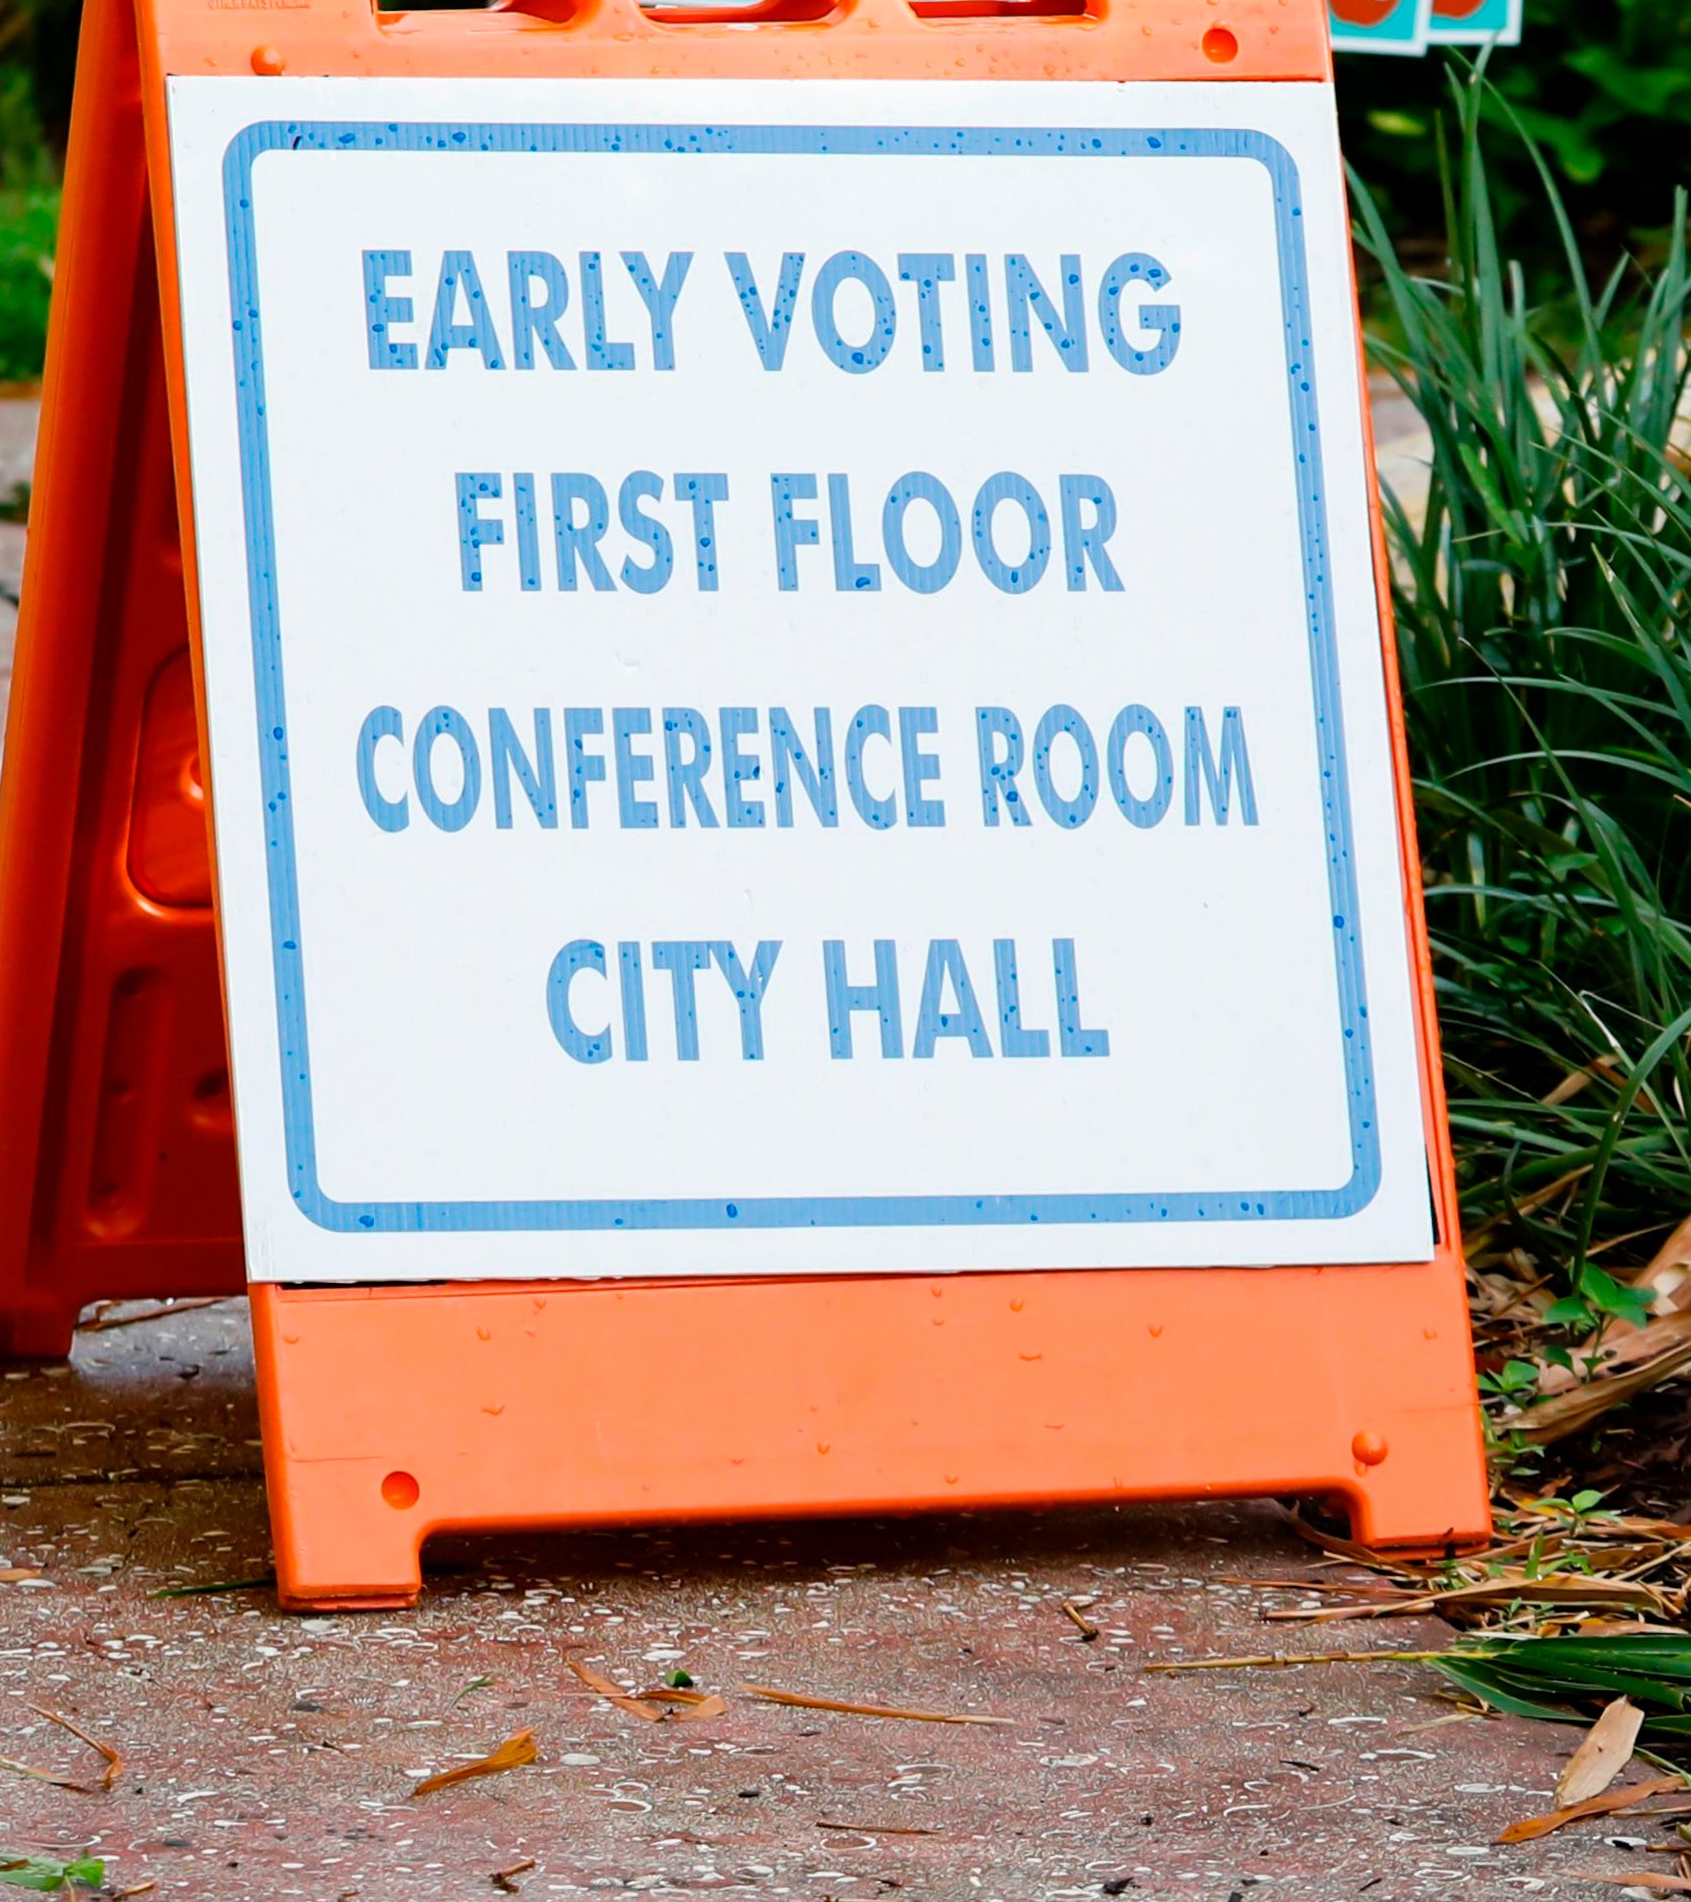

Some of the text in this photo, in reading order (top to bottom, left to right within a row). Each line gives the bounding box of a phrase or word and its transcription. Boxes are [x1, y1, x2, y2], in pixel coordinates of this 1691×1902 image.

[364, 251, 1181, 375] EARLY VOTING
[457, 472, 1125, 594] FIRST FLOOR
[357, 703, 1259, 833] CONFERENCE ROOM
[546, 938, 1109, 1064] CITY HALL
